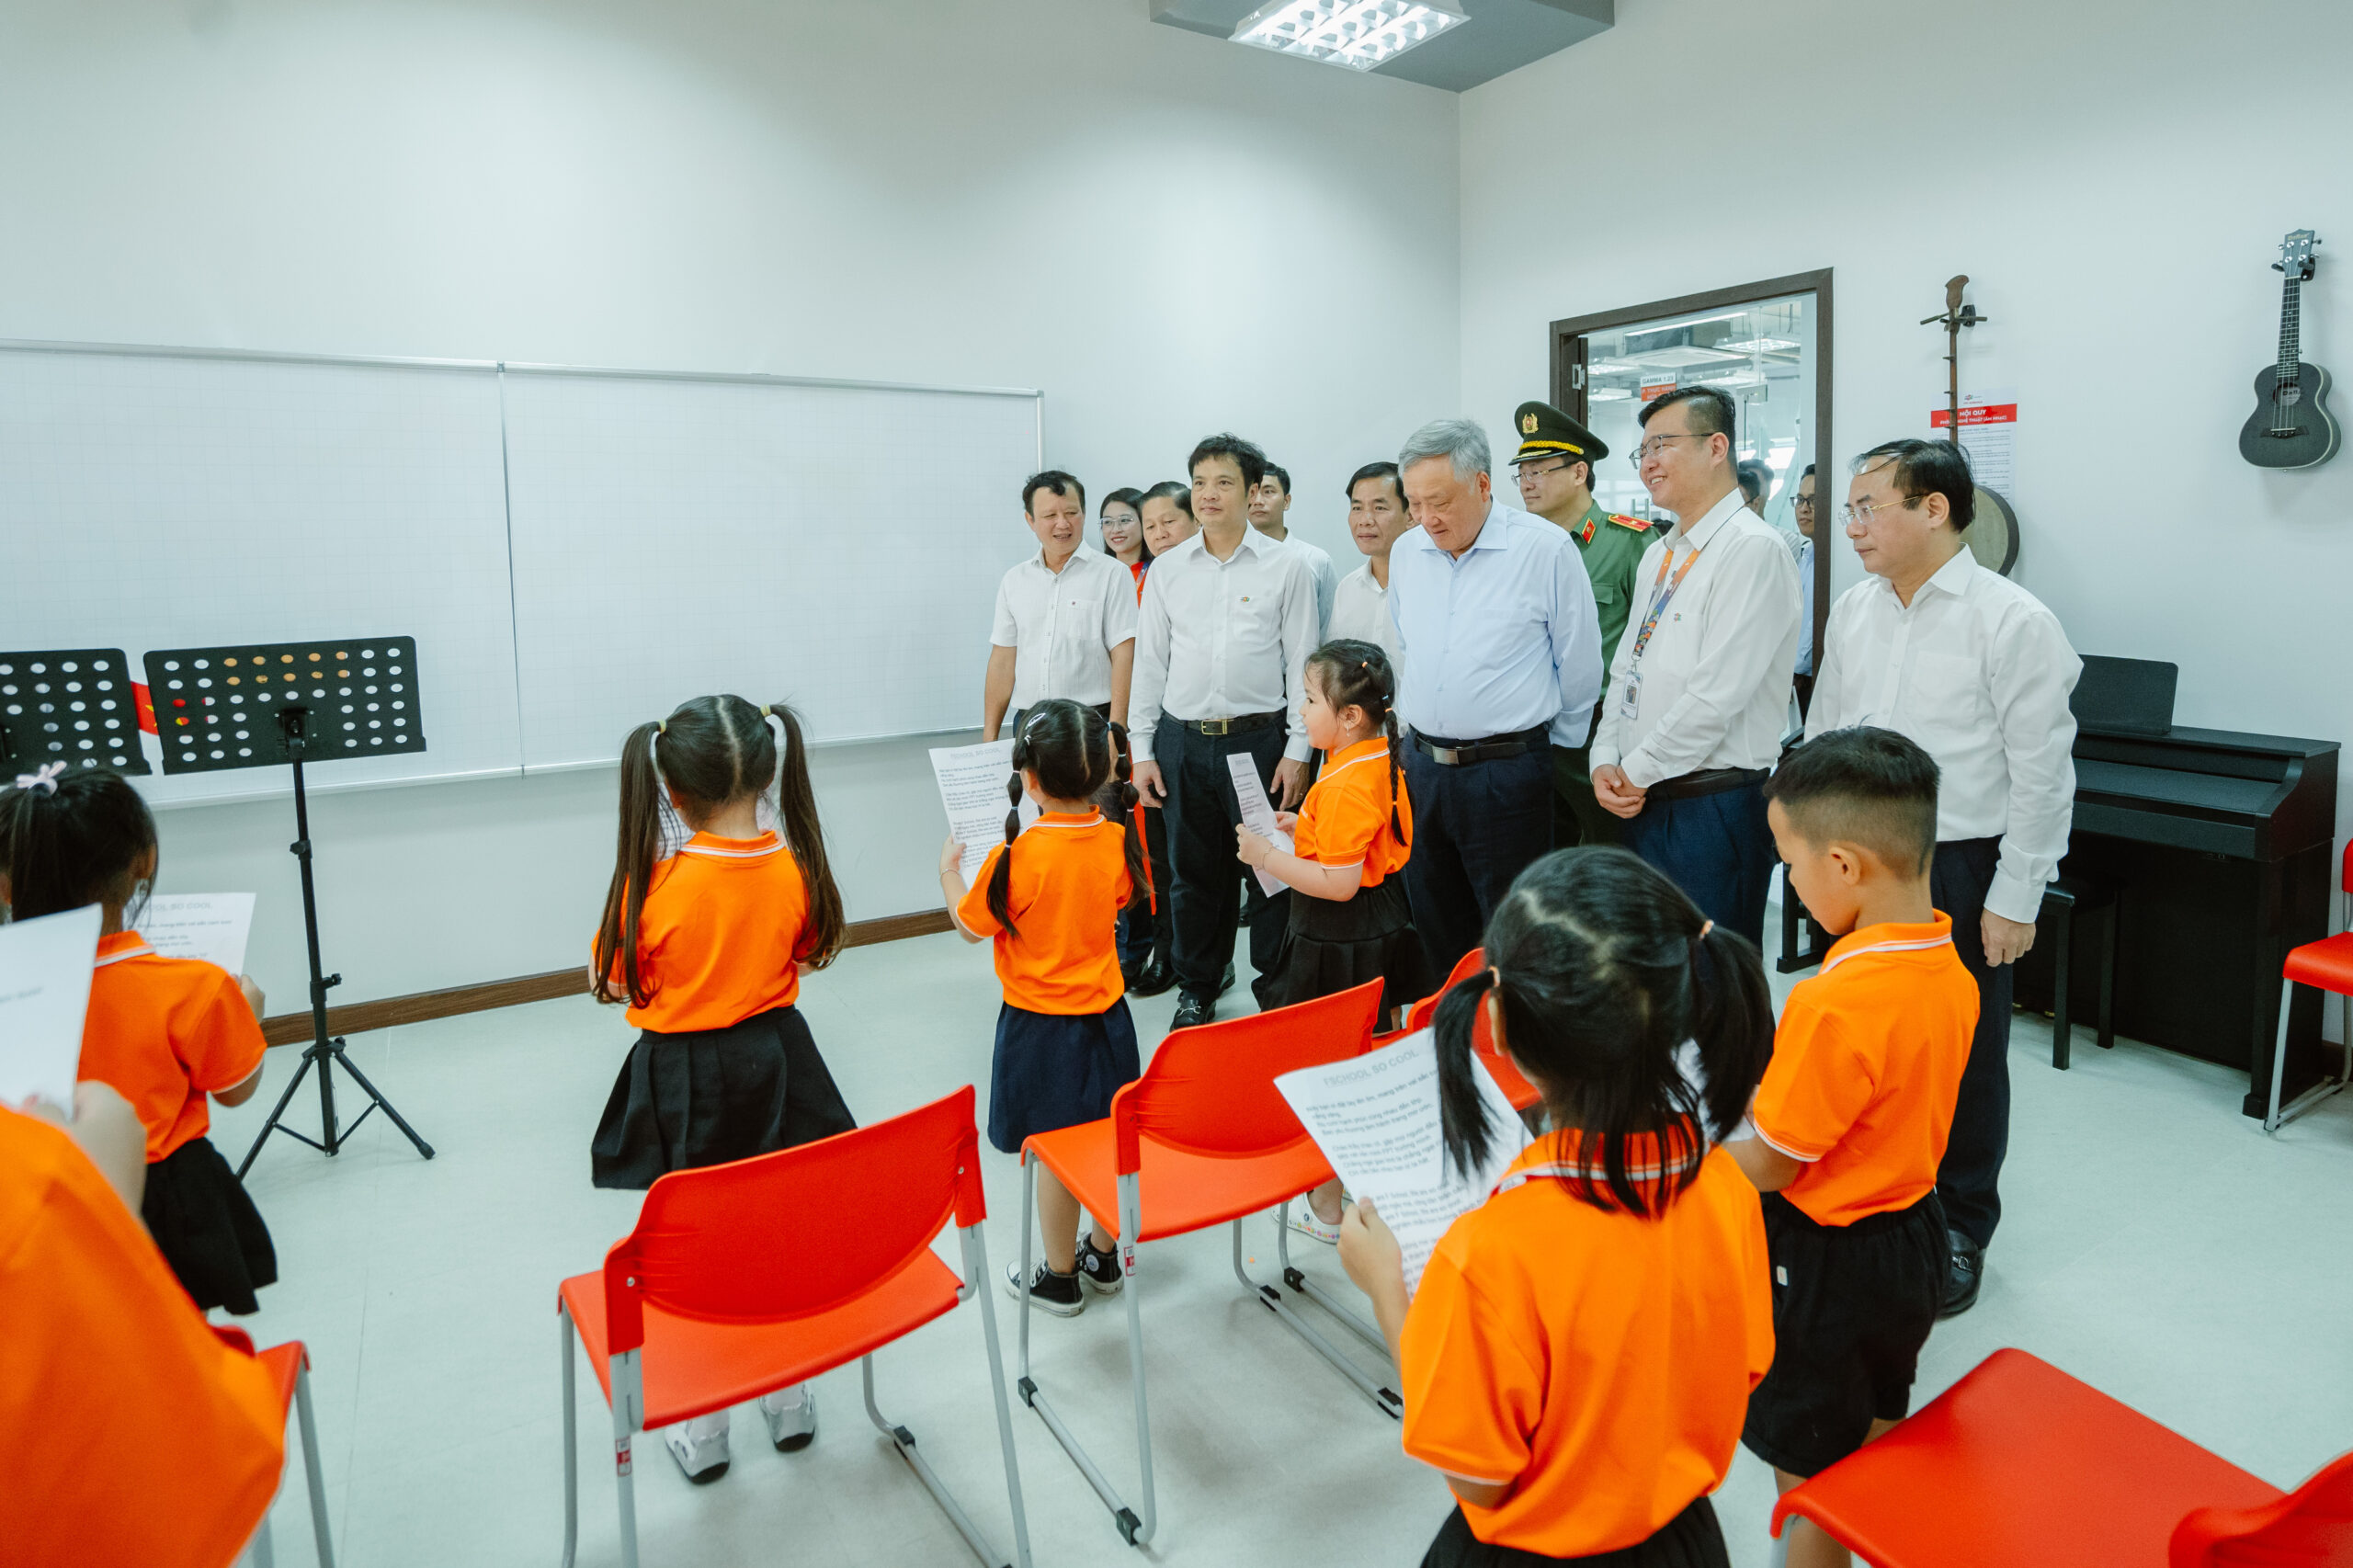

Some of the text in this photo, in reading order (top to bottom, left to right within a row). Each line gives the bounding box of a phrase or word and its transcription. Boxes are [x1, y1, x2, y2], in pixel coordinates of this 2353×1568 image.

[1959, 409, 1972, 417] NỘI
[1324, 1050, 1419, 1087] FSCHOOL SO COOL
